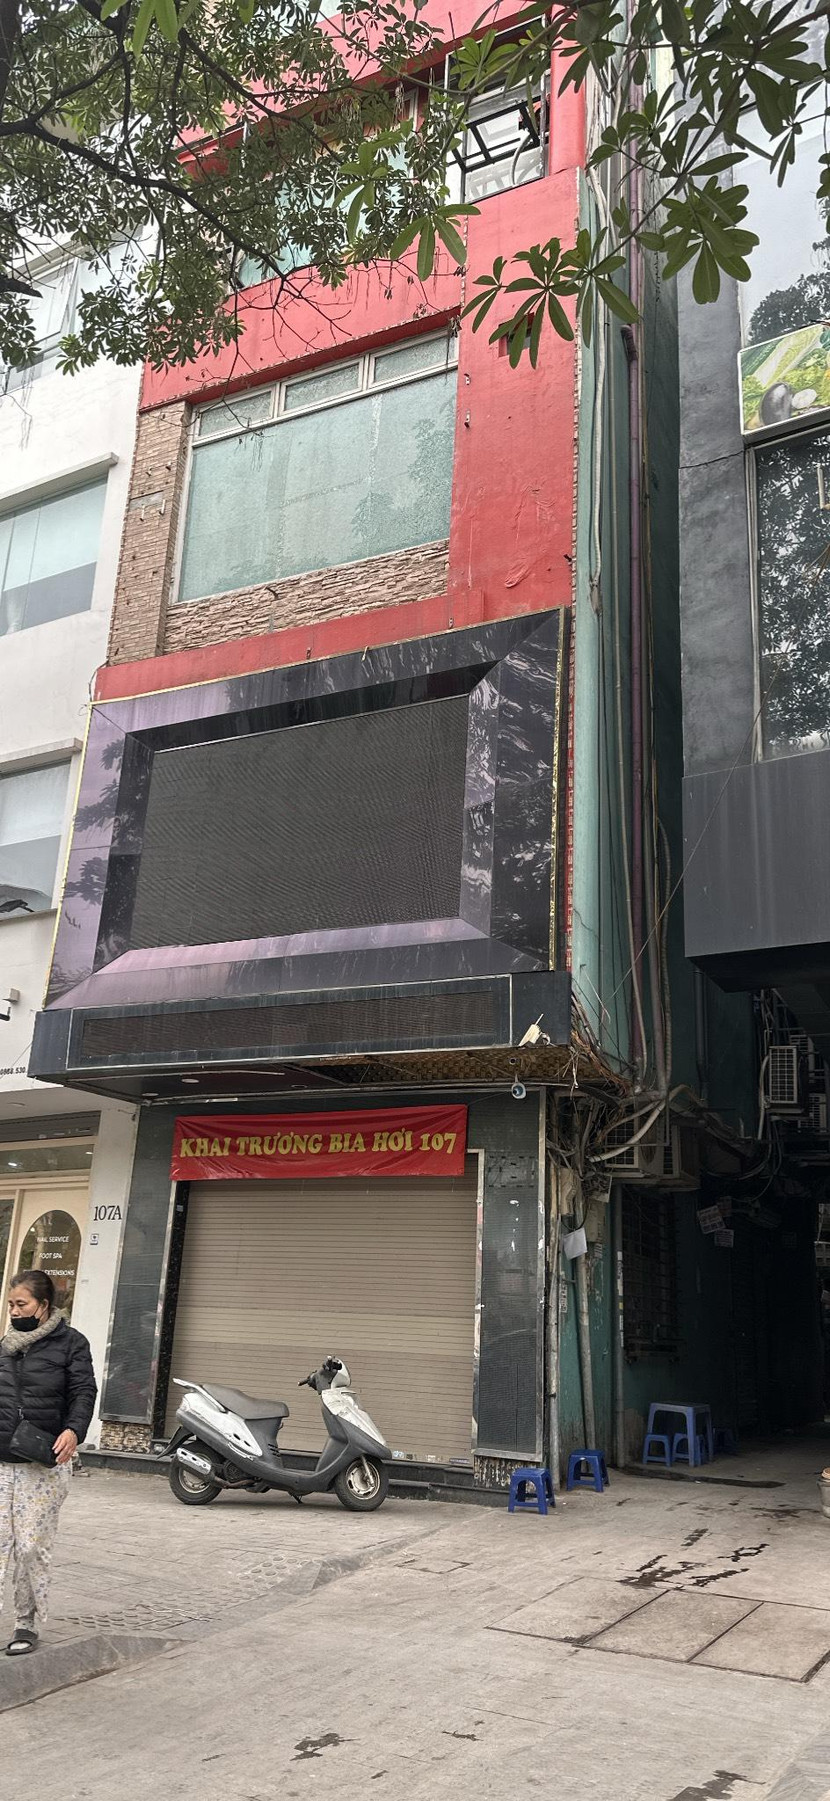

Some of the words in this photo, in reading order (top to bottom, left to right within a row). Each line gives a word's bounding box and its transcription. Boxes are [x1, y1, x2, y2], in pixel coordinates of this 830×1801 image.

[180, 1137, 231, 1157] KHAI
[236, 1132, 322, 1155] TRƯƠNG
[328, 1132, 366, 1153] BIA
[372, 1128, 413, 1152] HƠI
[419, 1132, 457, 1154] 107
[93, 1205, 122, 1221] 107A
